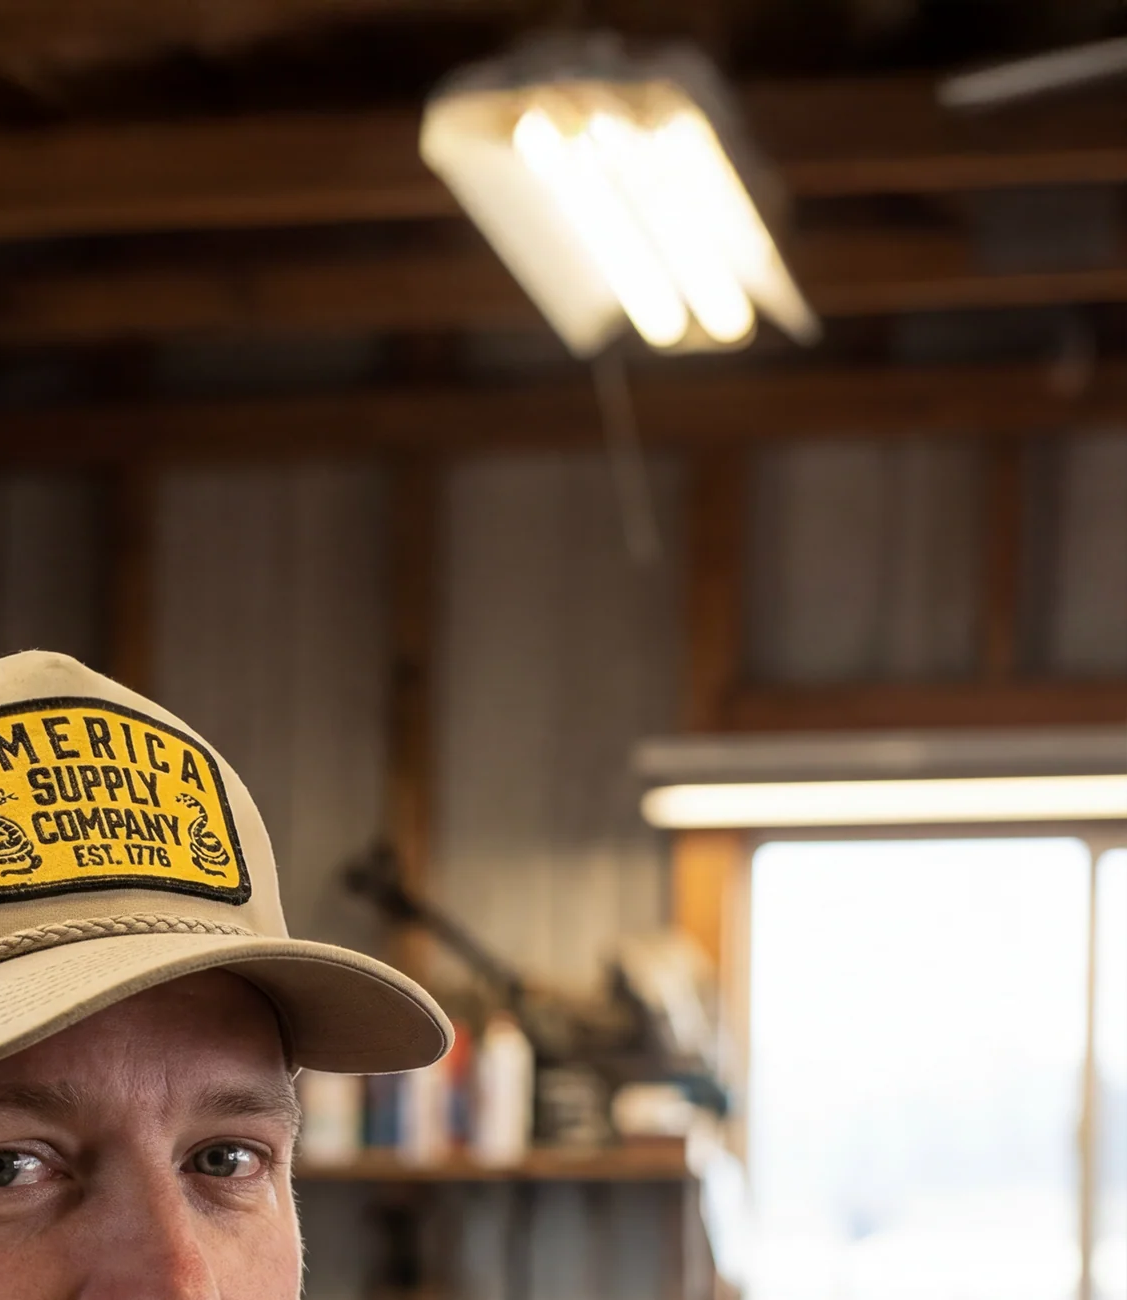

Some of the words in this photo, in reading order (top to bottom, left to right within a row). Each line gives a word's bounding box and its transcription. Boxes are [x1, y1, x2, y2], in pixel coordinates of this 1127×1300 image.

[27, 765, 161, 808] SUPPLY
[31, 807, 182, 846] COMPANY
[72, 843, 123, 867] EST.
[124, 843, 172, 868] 1776
